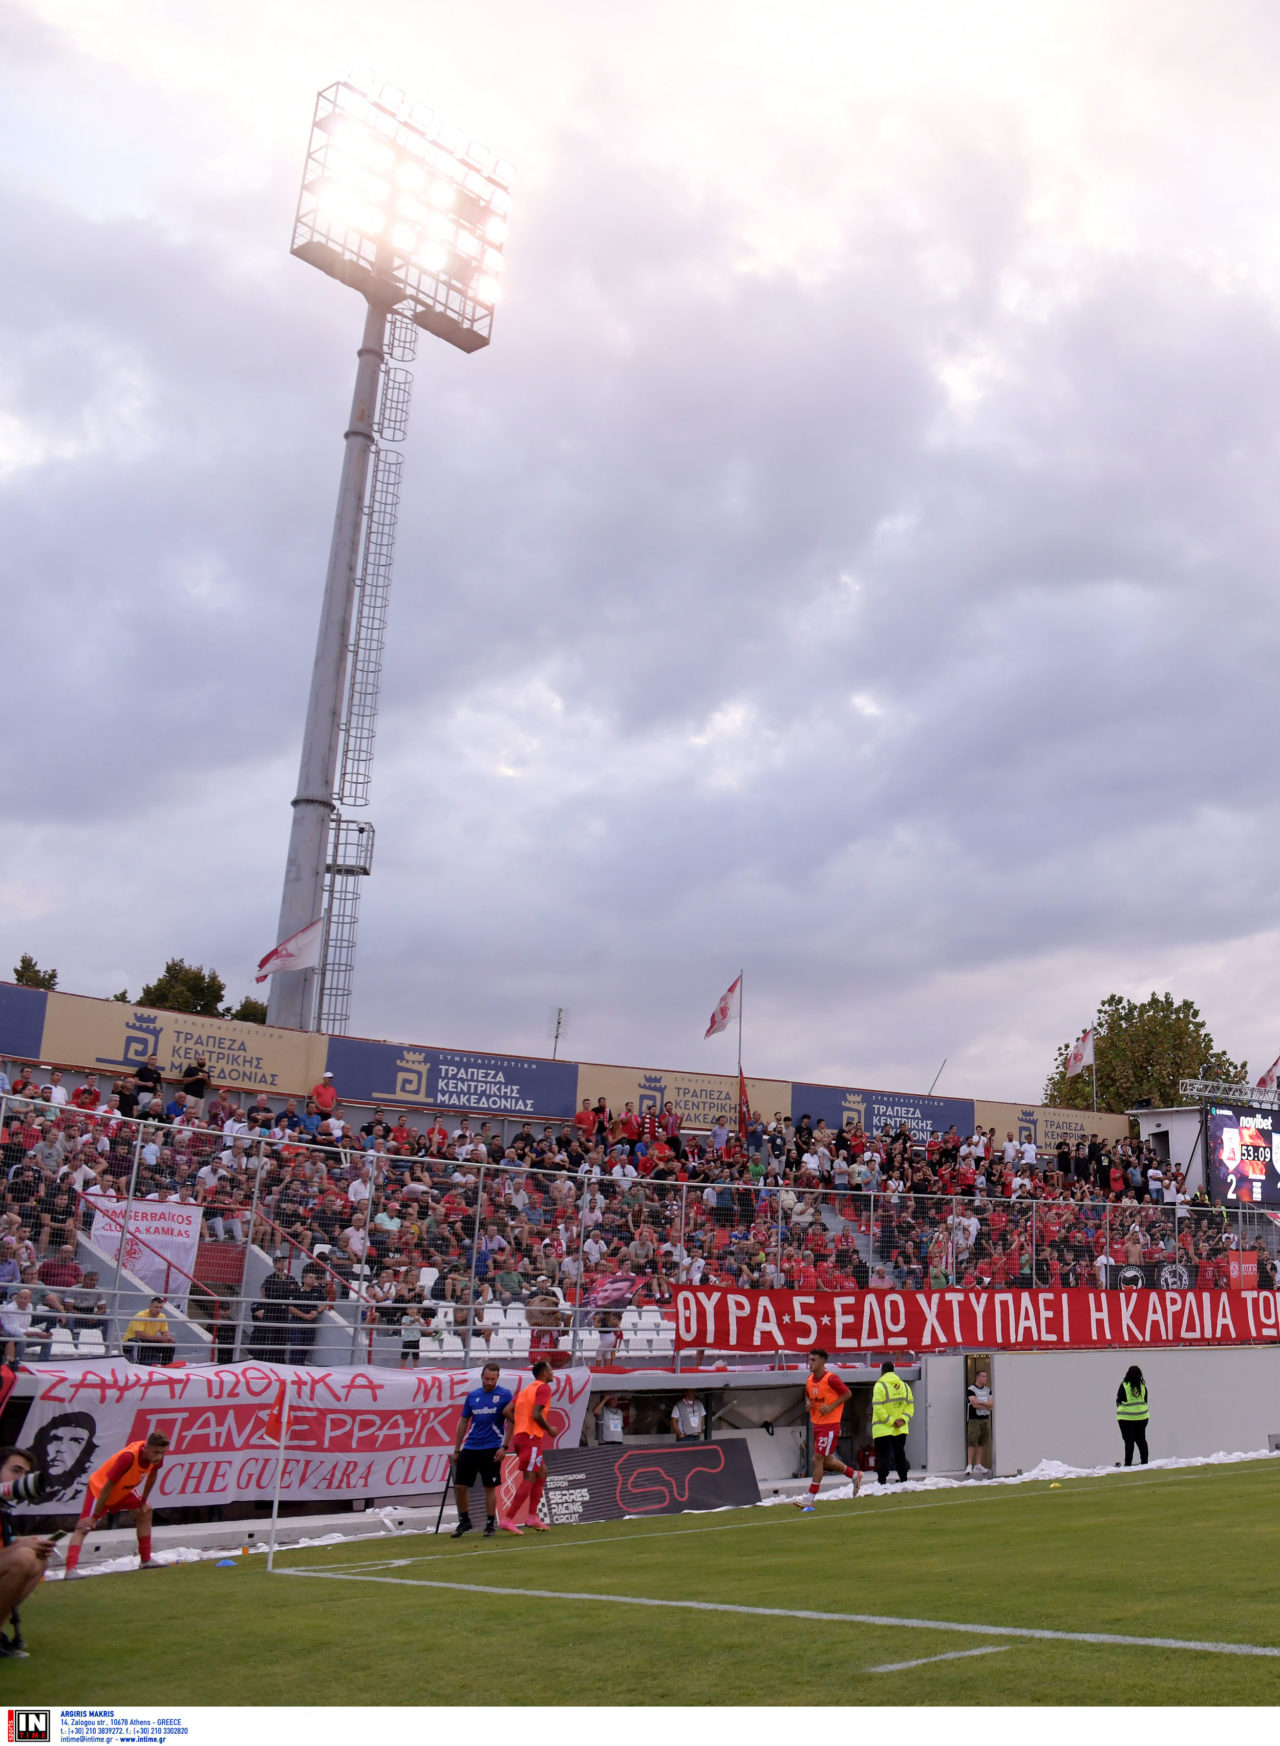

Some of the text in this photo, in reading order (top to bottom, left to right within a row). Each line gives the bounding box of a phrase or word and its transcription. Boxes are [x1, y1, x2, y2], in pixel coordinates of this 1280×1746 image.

[174, 1030, 247, 1053] ΤΡΑΠΕΖΑ
[172, 1046, 263, 1070] ΚΕΝΤΡΙΚΗΣ
[439, 1054, 537, 1069] ΣΥΝΕΤΑΙΡΙΣΤΙΚΗ
[170, 1061, 278, 1086] ΜΕΔΟΝΙΑΣ
[438, 1065, 505, 1083] ΤΡΑΠΕΖΑ
[438, 1079, 520, 1097] ΚΕΝΤΡΙΚΗΣ
[675, 1087, 732, 1101] ΤΡΑΠΕΖΑ
[437, 1092, 534, 1111] ΜΑΚΕΔΟΝΙΑΣ
[872, 1104, 921, 1118] ΤΡΑΠΕΖΑ
[1044, 1120, 1085, 1132] ΤΡΑΠΕΖΑ
[1240, 1113, 1272, 1130] novibet
[1241, 1145, 1271, 1162] 53:09
[1226, 1173, 1237, 1200] 2
[102, 1223, 126, 1233] CLU
[677, 1290, 785, 1346] ΘΥΡΑ
[793, 1295, 818, 1346] 5
[833, 1293, 908, 1348] ΕΔΩ
[916, 1291, 1069, 1346] ΧΤΥΠΑΕΙ
[1089, 1292, 1112, 1341] Η
[1119, 1292, 1236, 1342] ΚΑΡΔΙΑ
[412, 1371, 469, 1404] ΜΕ
[146, 1407, 453, 1450] ΠΑΝΣΕΡΡΑΪΚ
[159, 1458, 232, 1497] CHE
[236, 1456, 375, 1491] GUEVARA
[548, 1488, 590, 1504] SERRES
[550, 1501, 584, 1515] RACING
[553, 1513, 580, 1524] CIRCUIT
